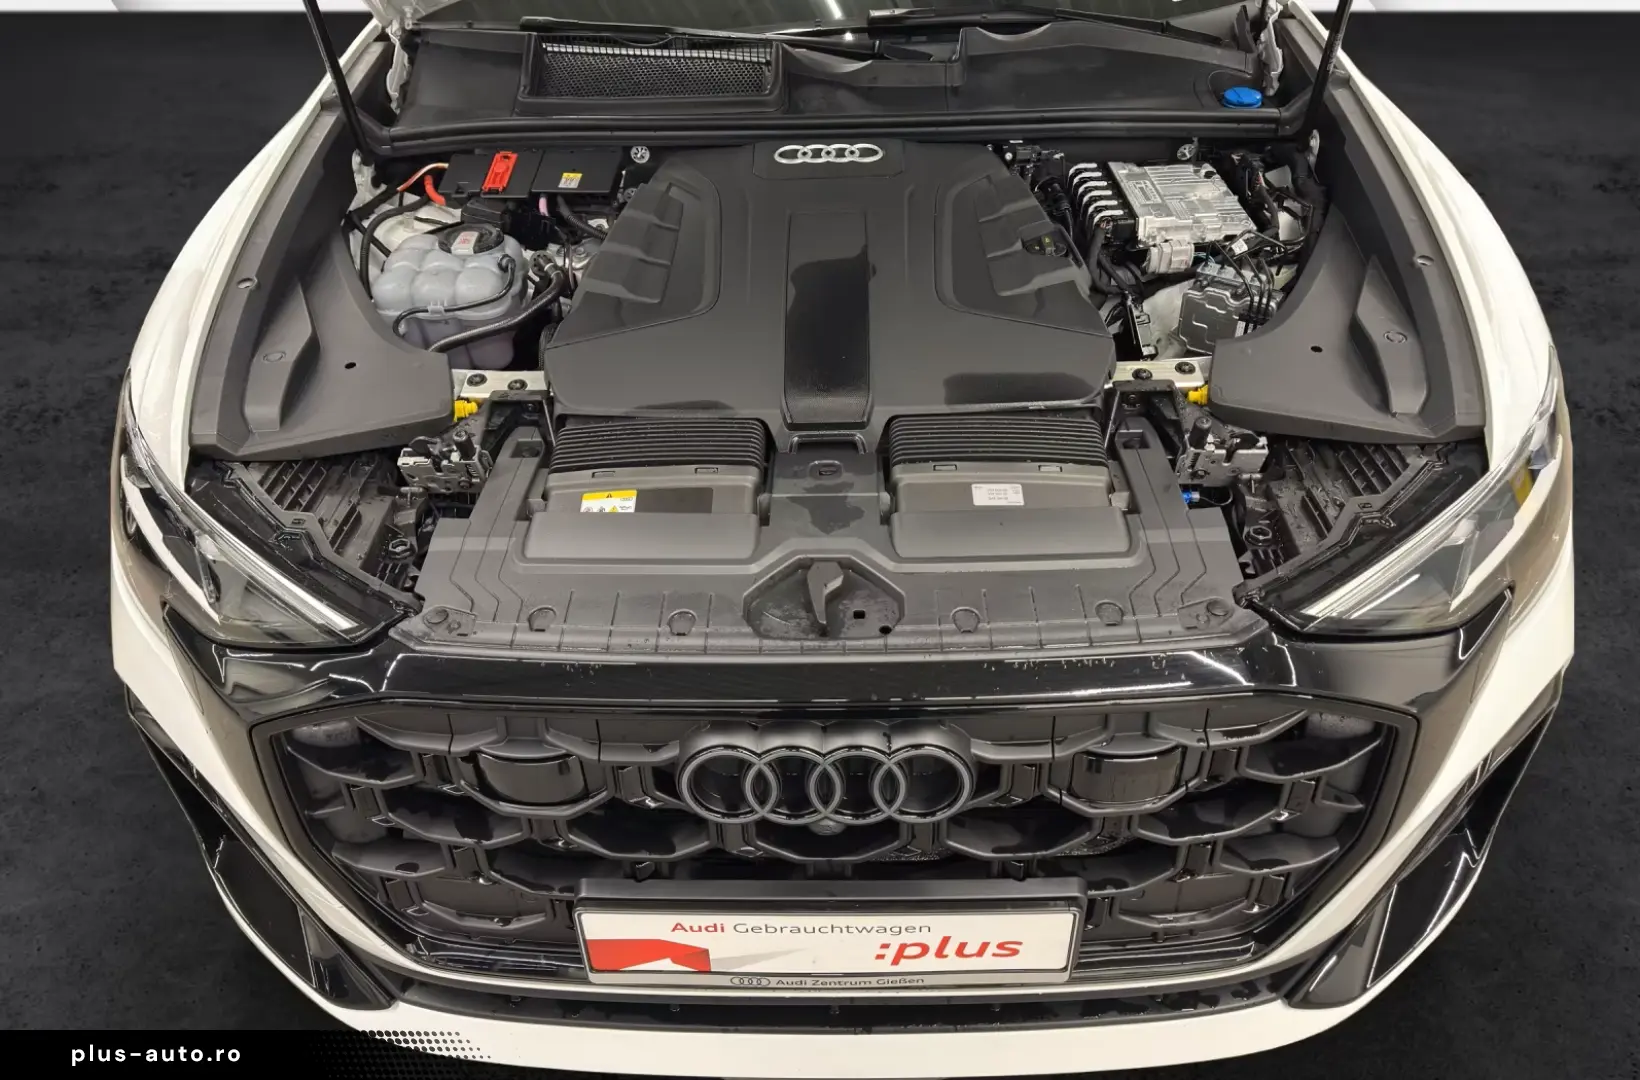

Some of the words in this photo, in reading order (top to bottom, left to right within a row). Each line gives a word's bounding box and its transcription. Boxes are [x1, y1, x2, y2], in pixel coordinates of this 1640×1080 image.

[670, 922, 726, 934] Audi
[732, 921, 932, 935] Gebrauchtwagen
[875, 936, 1022, 965] :plus
